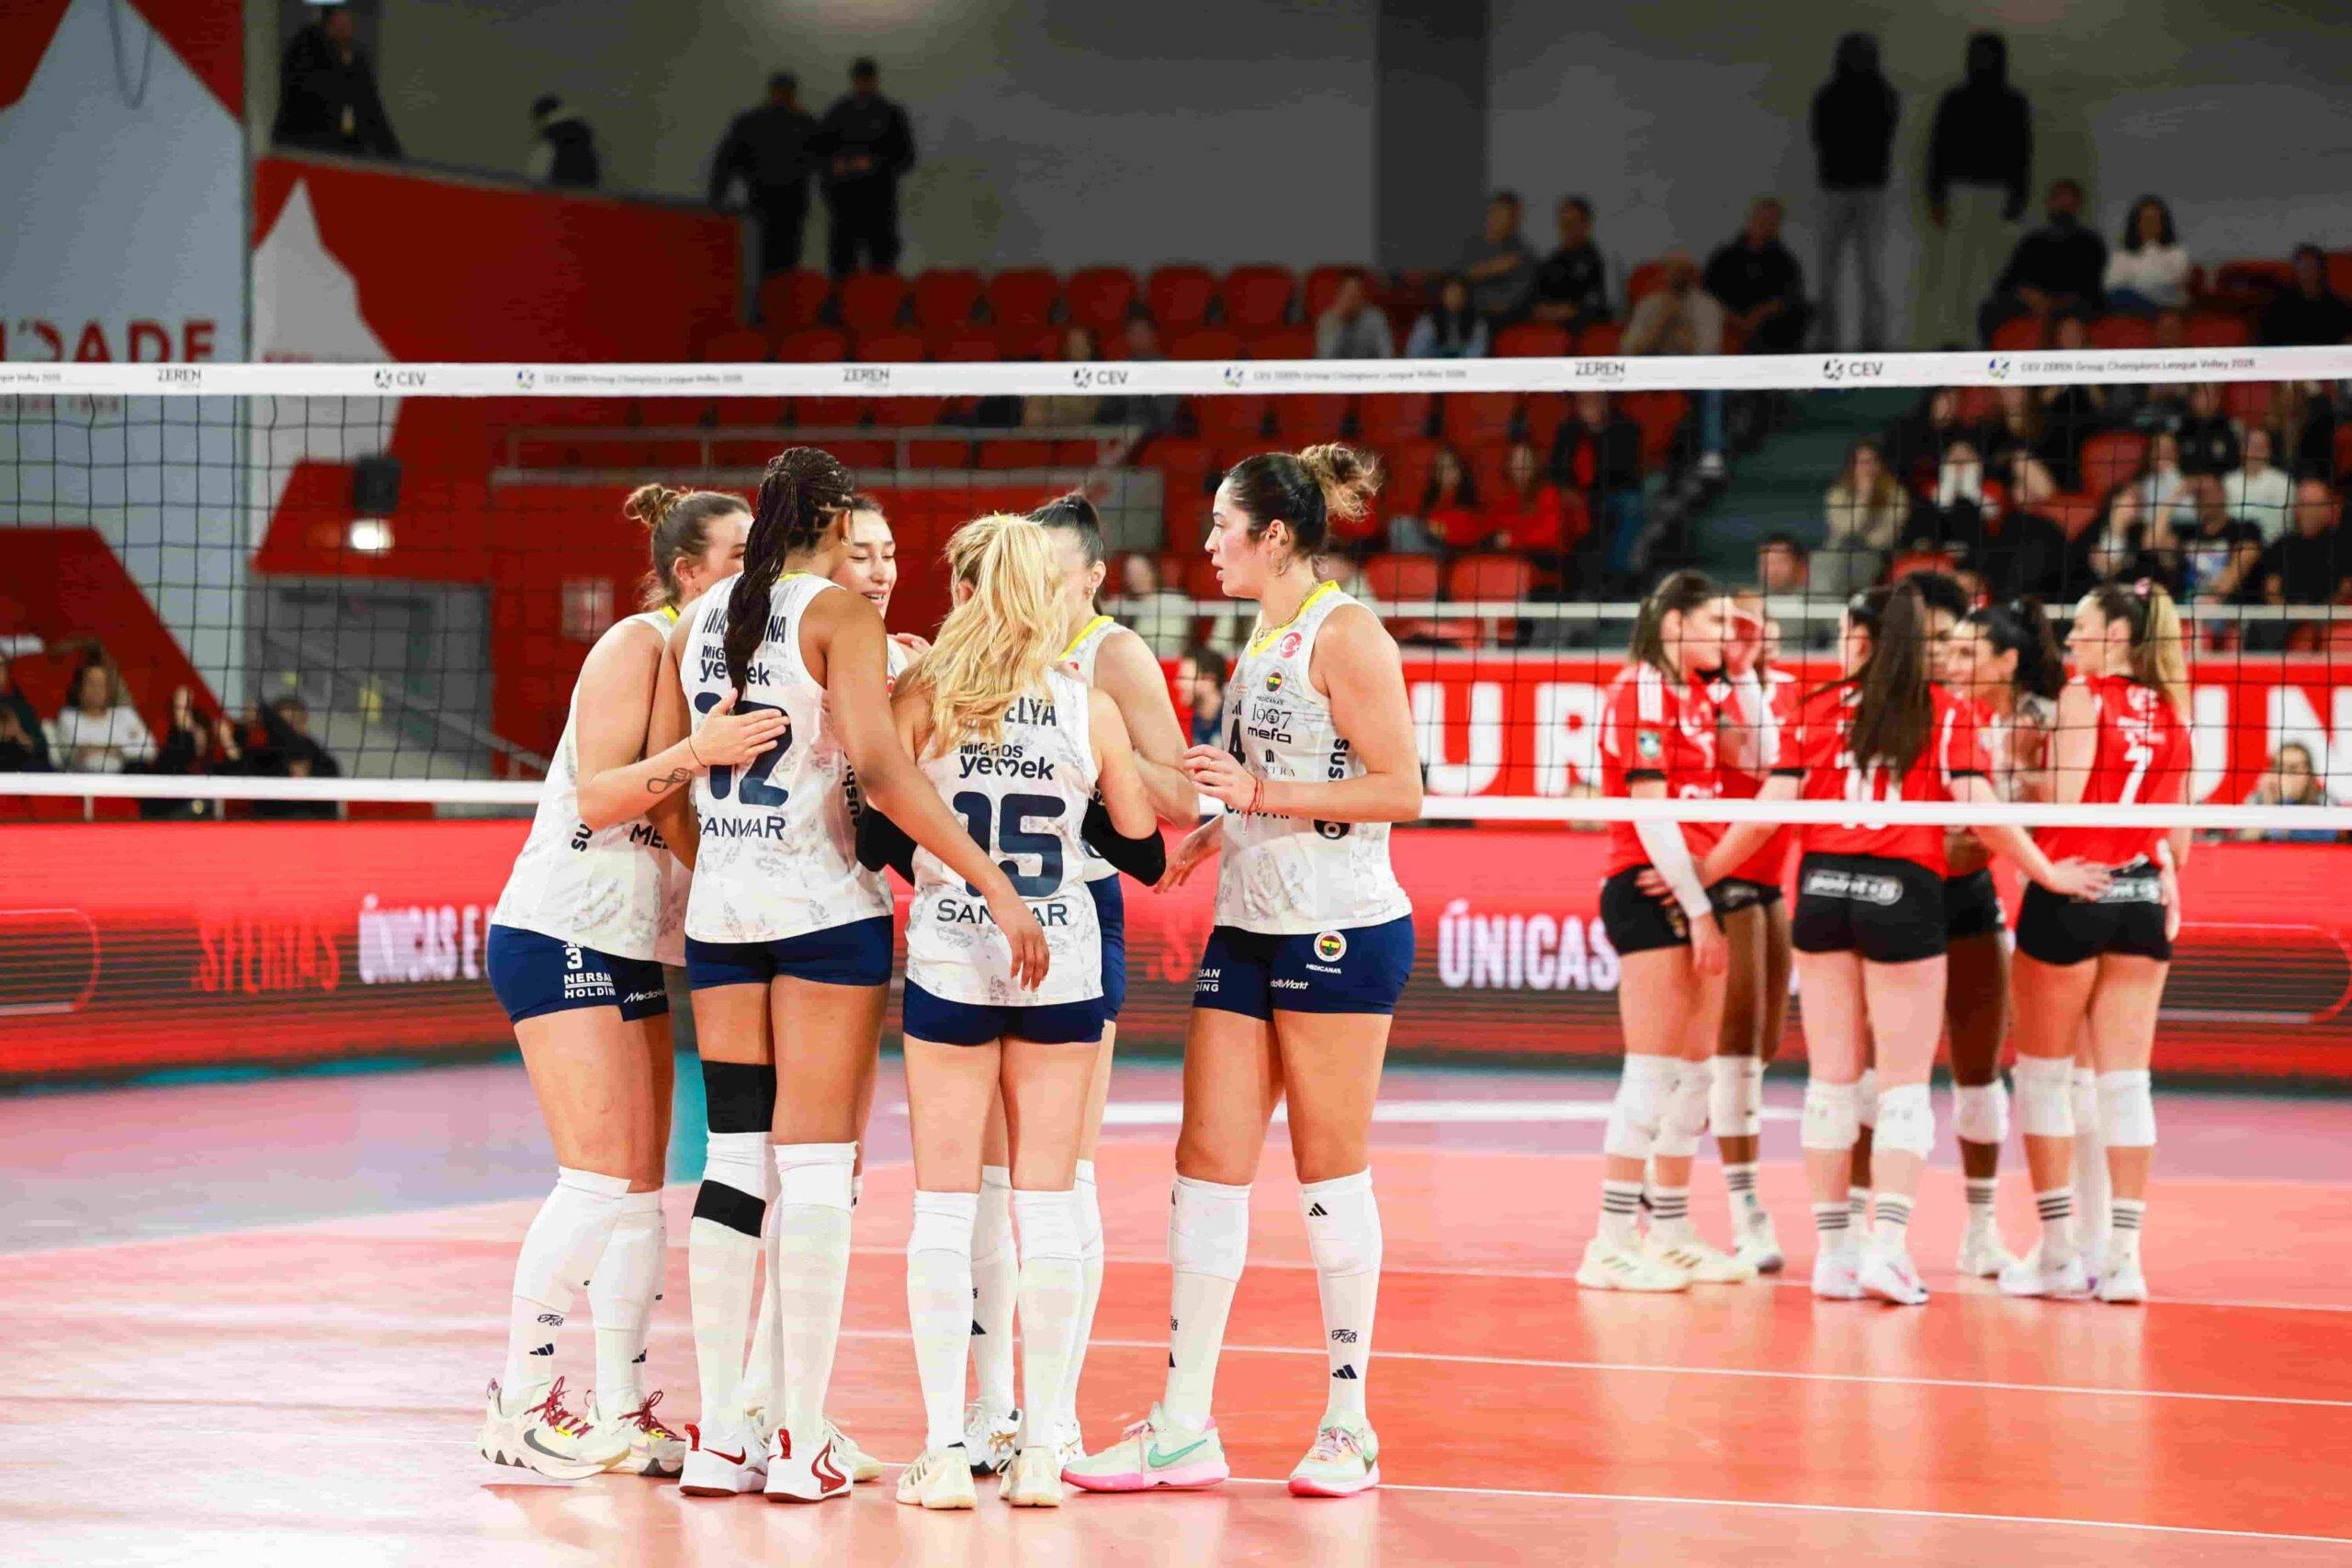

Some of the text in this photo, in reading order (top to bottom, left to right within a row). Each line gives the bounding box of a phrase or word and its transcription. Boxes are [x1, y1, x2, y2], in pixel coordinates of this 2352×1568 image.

[157, 368, 201, 382] ZEREN
[397, 372, 426, 386] CEV
[843, 367, 889, 381] ZEREN
[1097, 371, 1128, 385] CEV
[1576, 362, 1624, 376] ZEREN
[1849, 362, 1883, 377] CEV
[699, 659, 770, 687] yeek
[1248, 727, 1292, 745] mefa
[959, 756, 1055, 781] yemek
[696, 812, 786, 840] ANMAR
[953, 791, 1067, 897] 15
[936, 898, 1068, 926] SANAR
[1438, 898, 1620, 991] ÚNICAS
[565, 947, 582, 969] 3
